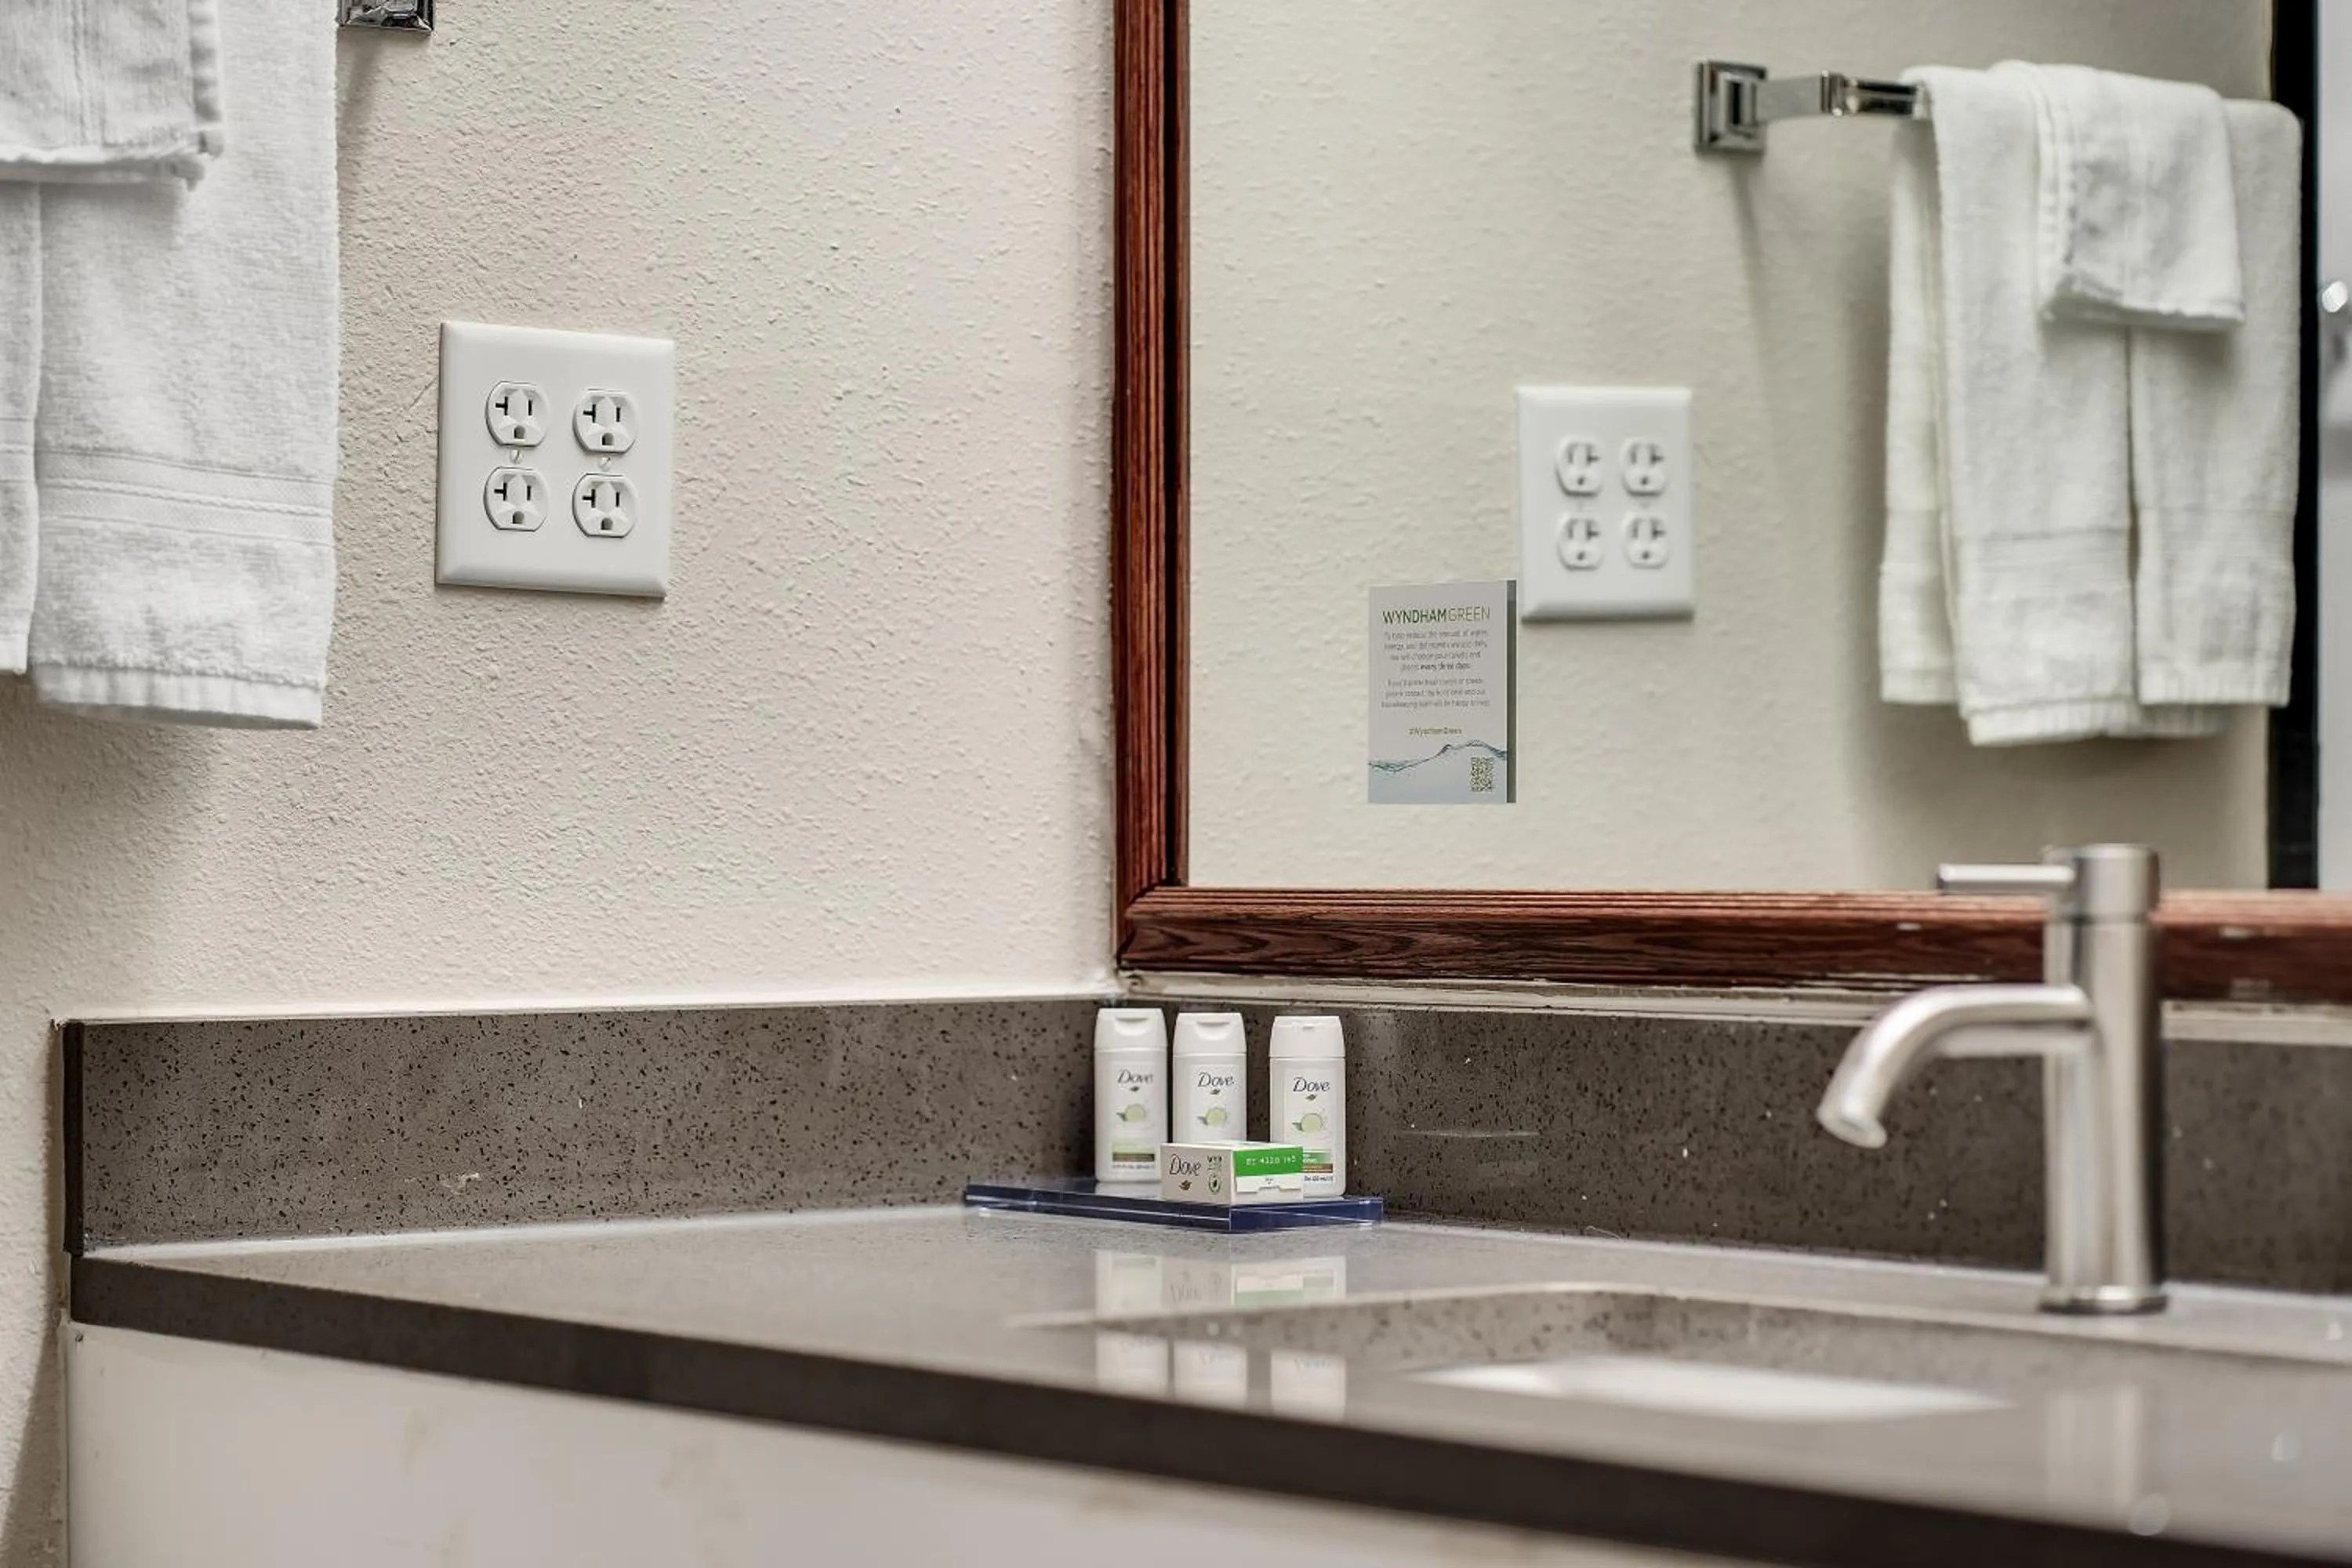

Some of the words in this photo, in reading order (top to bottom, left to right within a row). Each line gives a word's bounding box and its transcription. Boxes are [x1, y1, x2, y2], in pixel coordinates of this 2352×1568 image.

[1117, 1069, 1154, 1084] Dove
[1197, 1072, 1234, 1087] Dove
[1292, 1076, 1330, 1092] Dove
[1169, 1153, 1202, 1177] Dove
